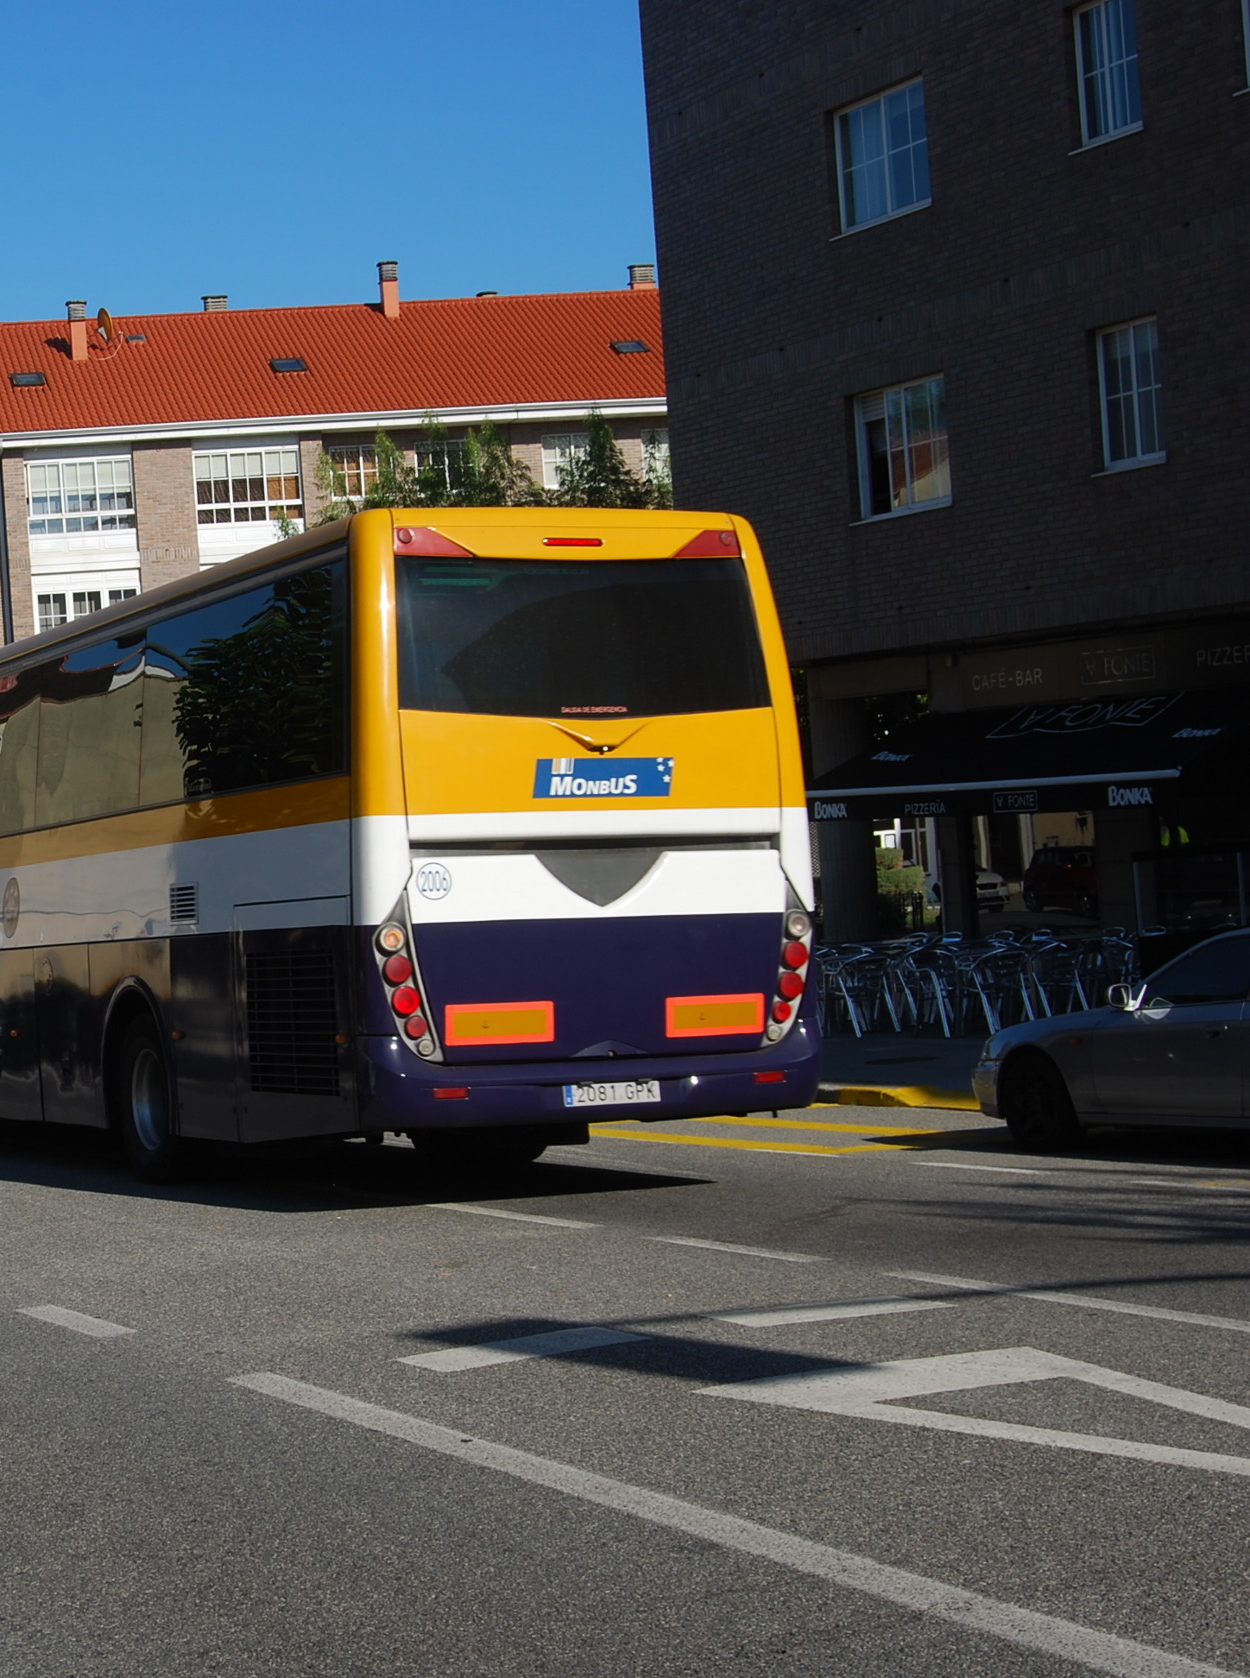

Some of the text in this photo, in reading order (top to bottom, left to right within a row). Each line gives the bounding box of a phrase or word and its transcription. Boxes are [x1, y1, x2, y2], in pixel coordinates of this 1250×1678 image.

[1103, 652, 1150, 676] FONTE
[1045, 696, 1166, 726] FONTE
[1007, 794, 1035, 808] FONTE
[1107, 785, 1154, 808] BONKA
[814, 801, 848, 819] BONKA
[420, 871, 449, 892] 2006
[577, 1082, 656, 1103] 2081 GPK
